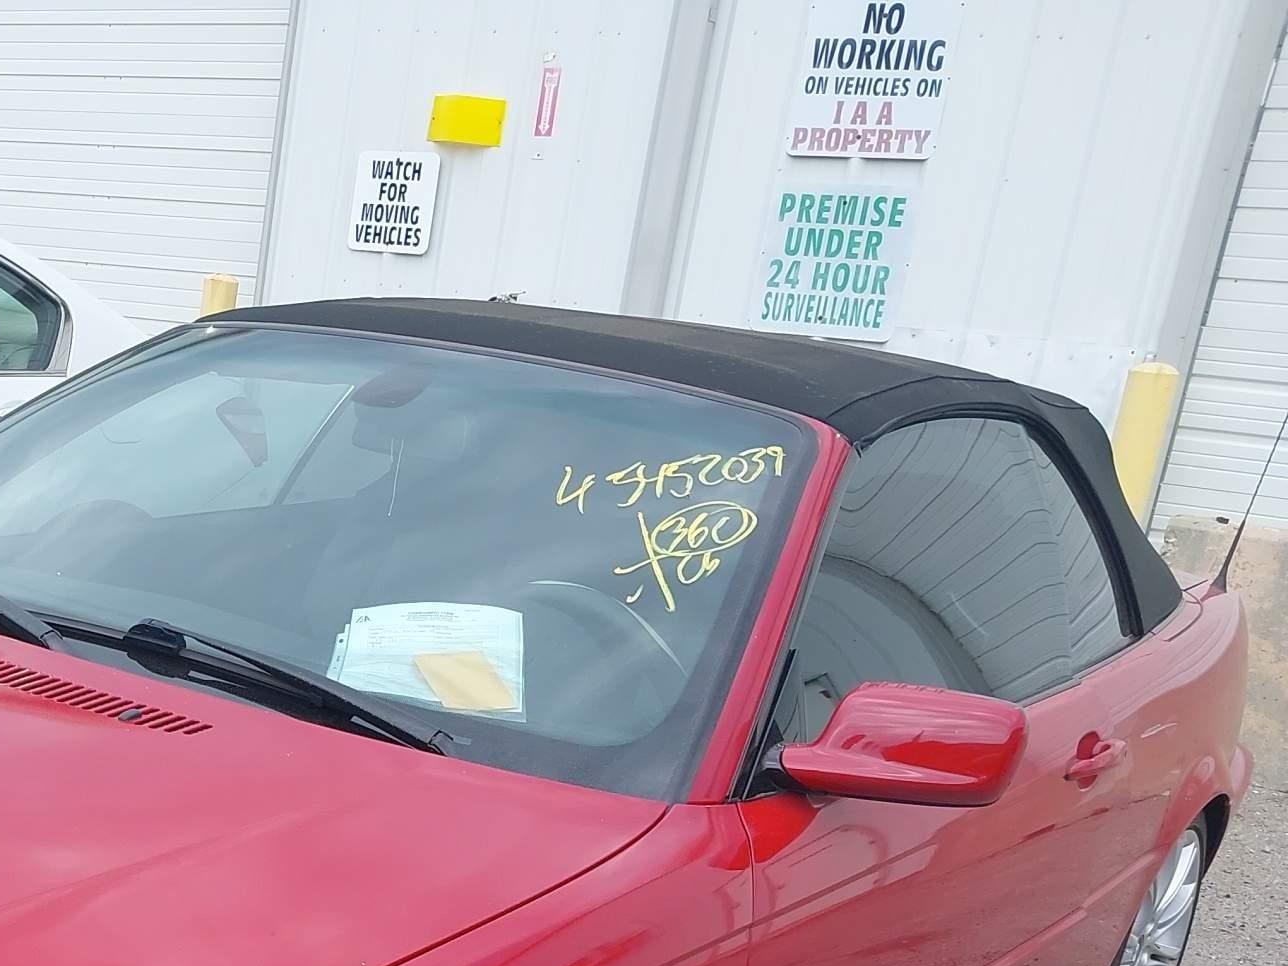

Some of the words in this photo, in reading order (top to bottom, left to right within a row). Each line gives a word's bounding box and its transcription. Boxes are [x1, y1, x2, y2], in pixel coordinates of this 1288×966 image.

[863, 3, 905, 35] NO
[813, 38, 946, 71] WORKING
[805, 76, 828, 94] ON
[834, 77, 911, 96] VEHICLES
[916, 79, 942, 97] ON
[791, 127, 931, 154] PROPERTY
[372, 160, 422, 181] WATCH
[378, 182, 407, 202] FOR
[361, 203, 420, 225] MOVING
[778, 193, 907, 228] PREMISE
[355, 224, 421, 247] VEHICLES
[784, 227, 883, 261] UNDER
[766, 259, 801, 289] 24
[811, 262, 890, 295] HOUR
[762, 292, 885, 329] SURVEILLANCE
